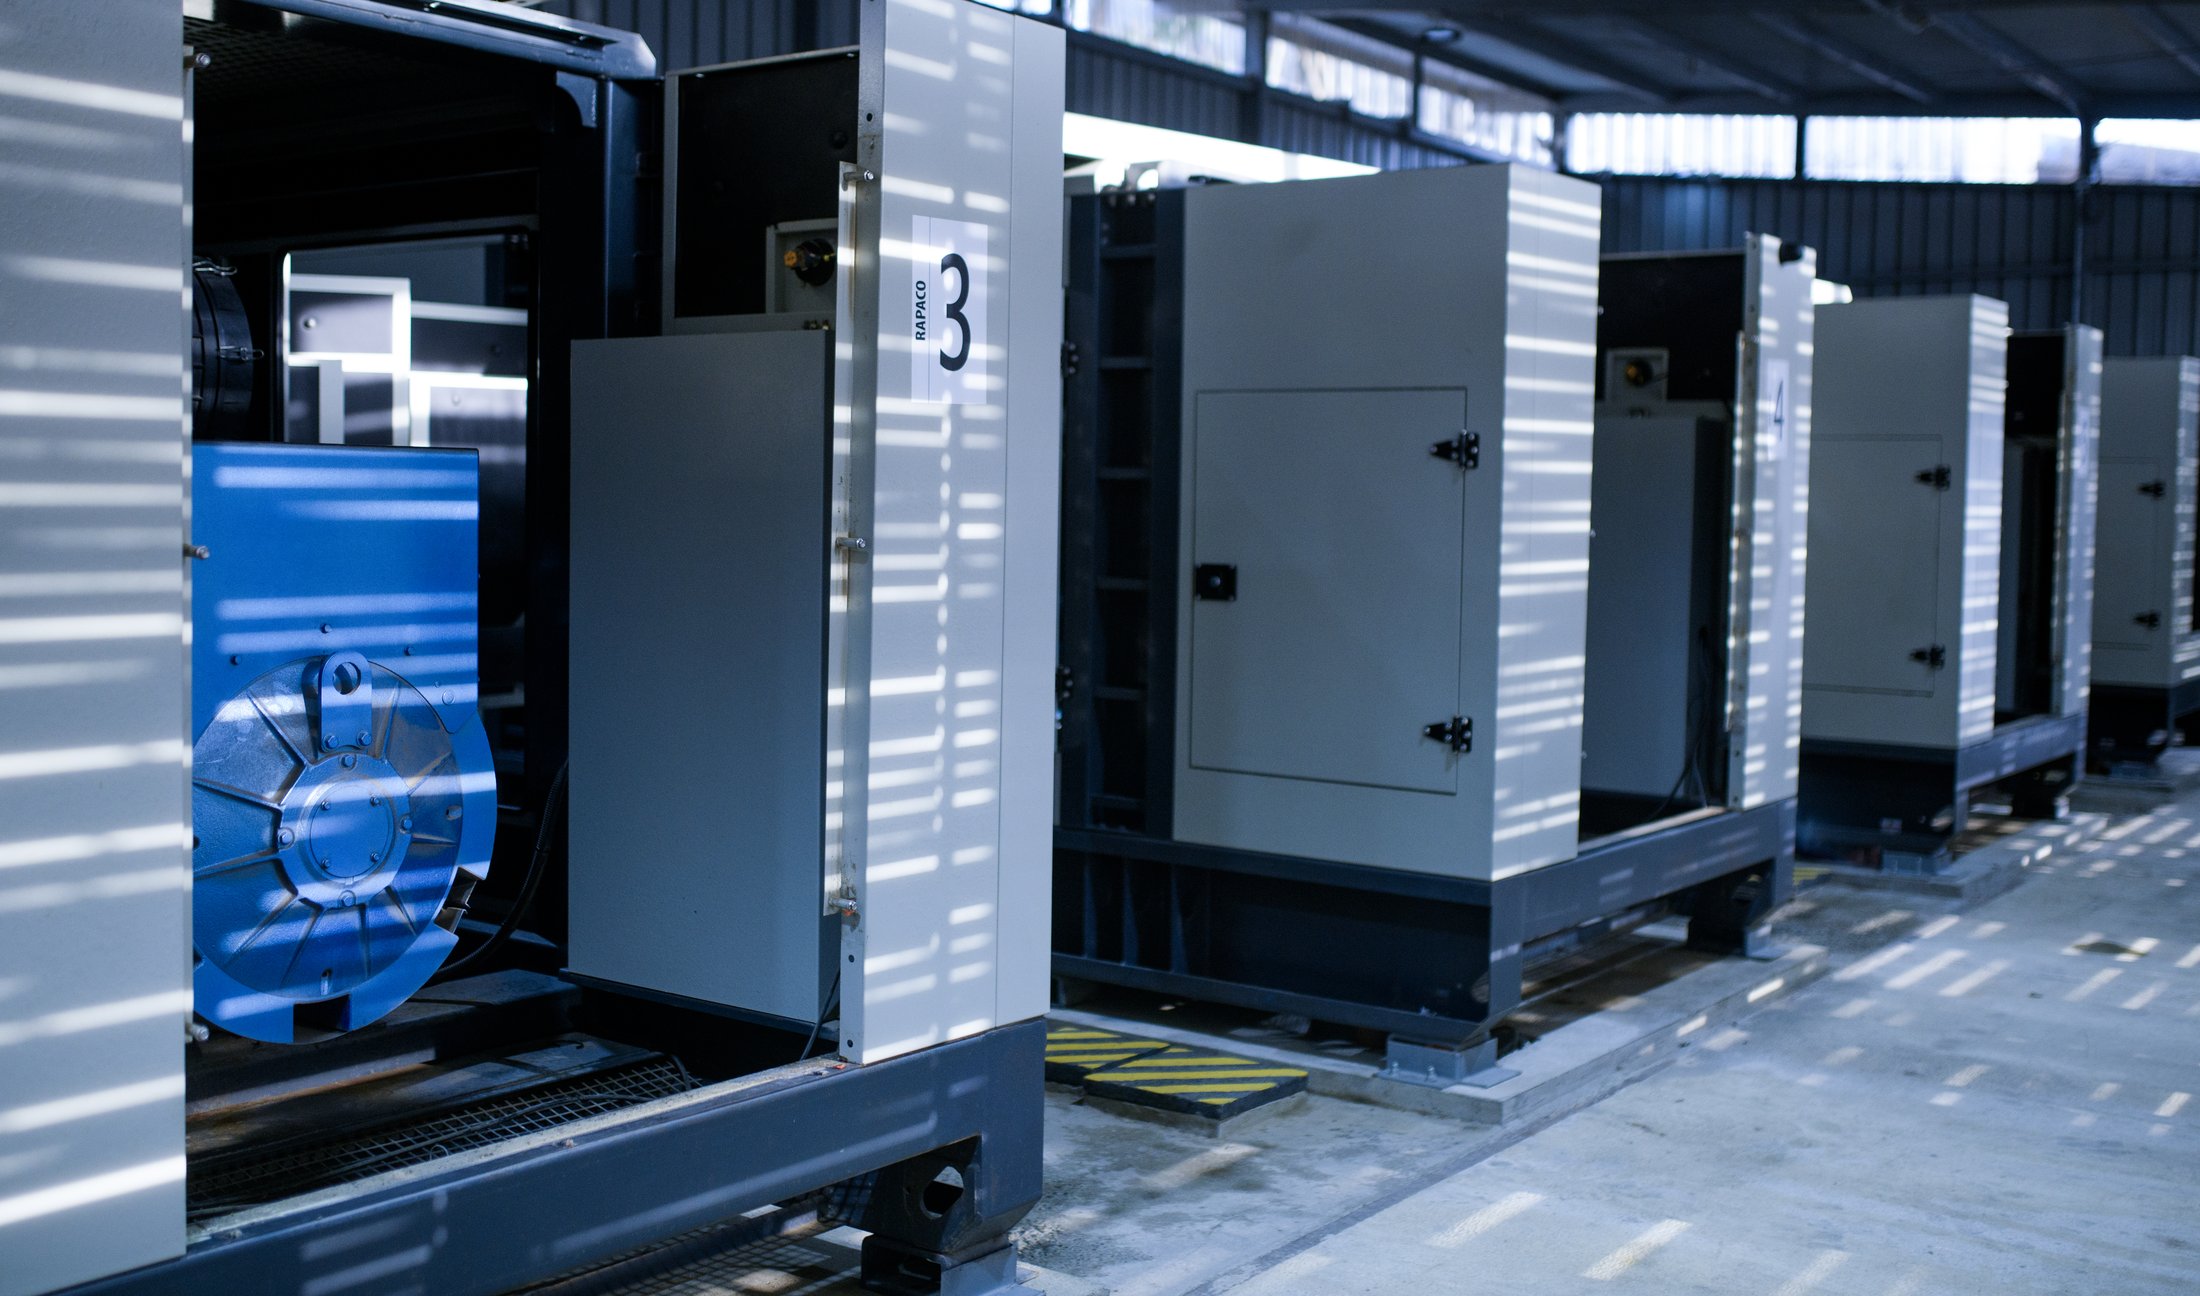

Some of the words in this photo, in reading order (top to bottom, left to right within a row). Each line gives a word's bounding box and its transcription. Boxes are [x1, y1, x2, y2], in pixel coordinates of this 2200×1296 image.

[915, 280, 926, 340] RAPACO
[940, 253, 971, 371] 3
[1773, 379, 1784, 440] 4
